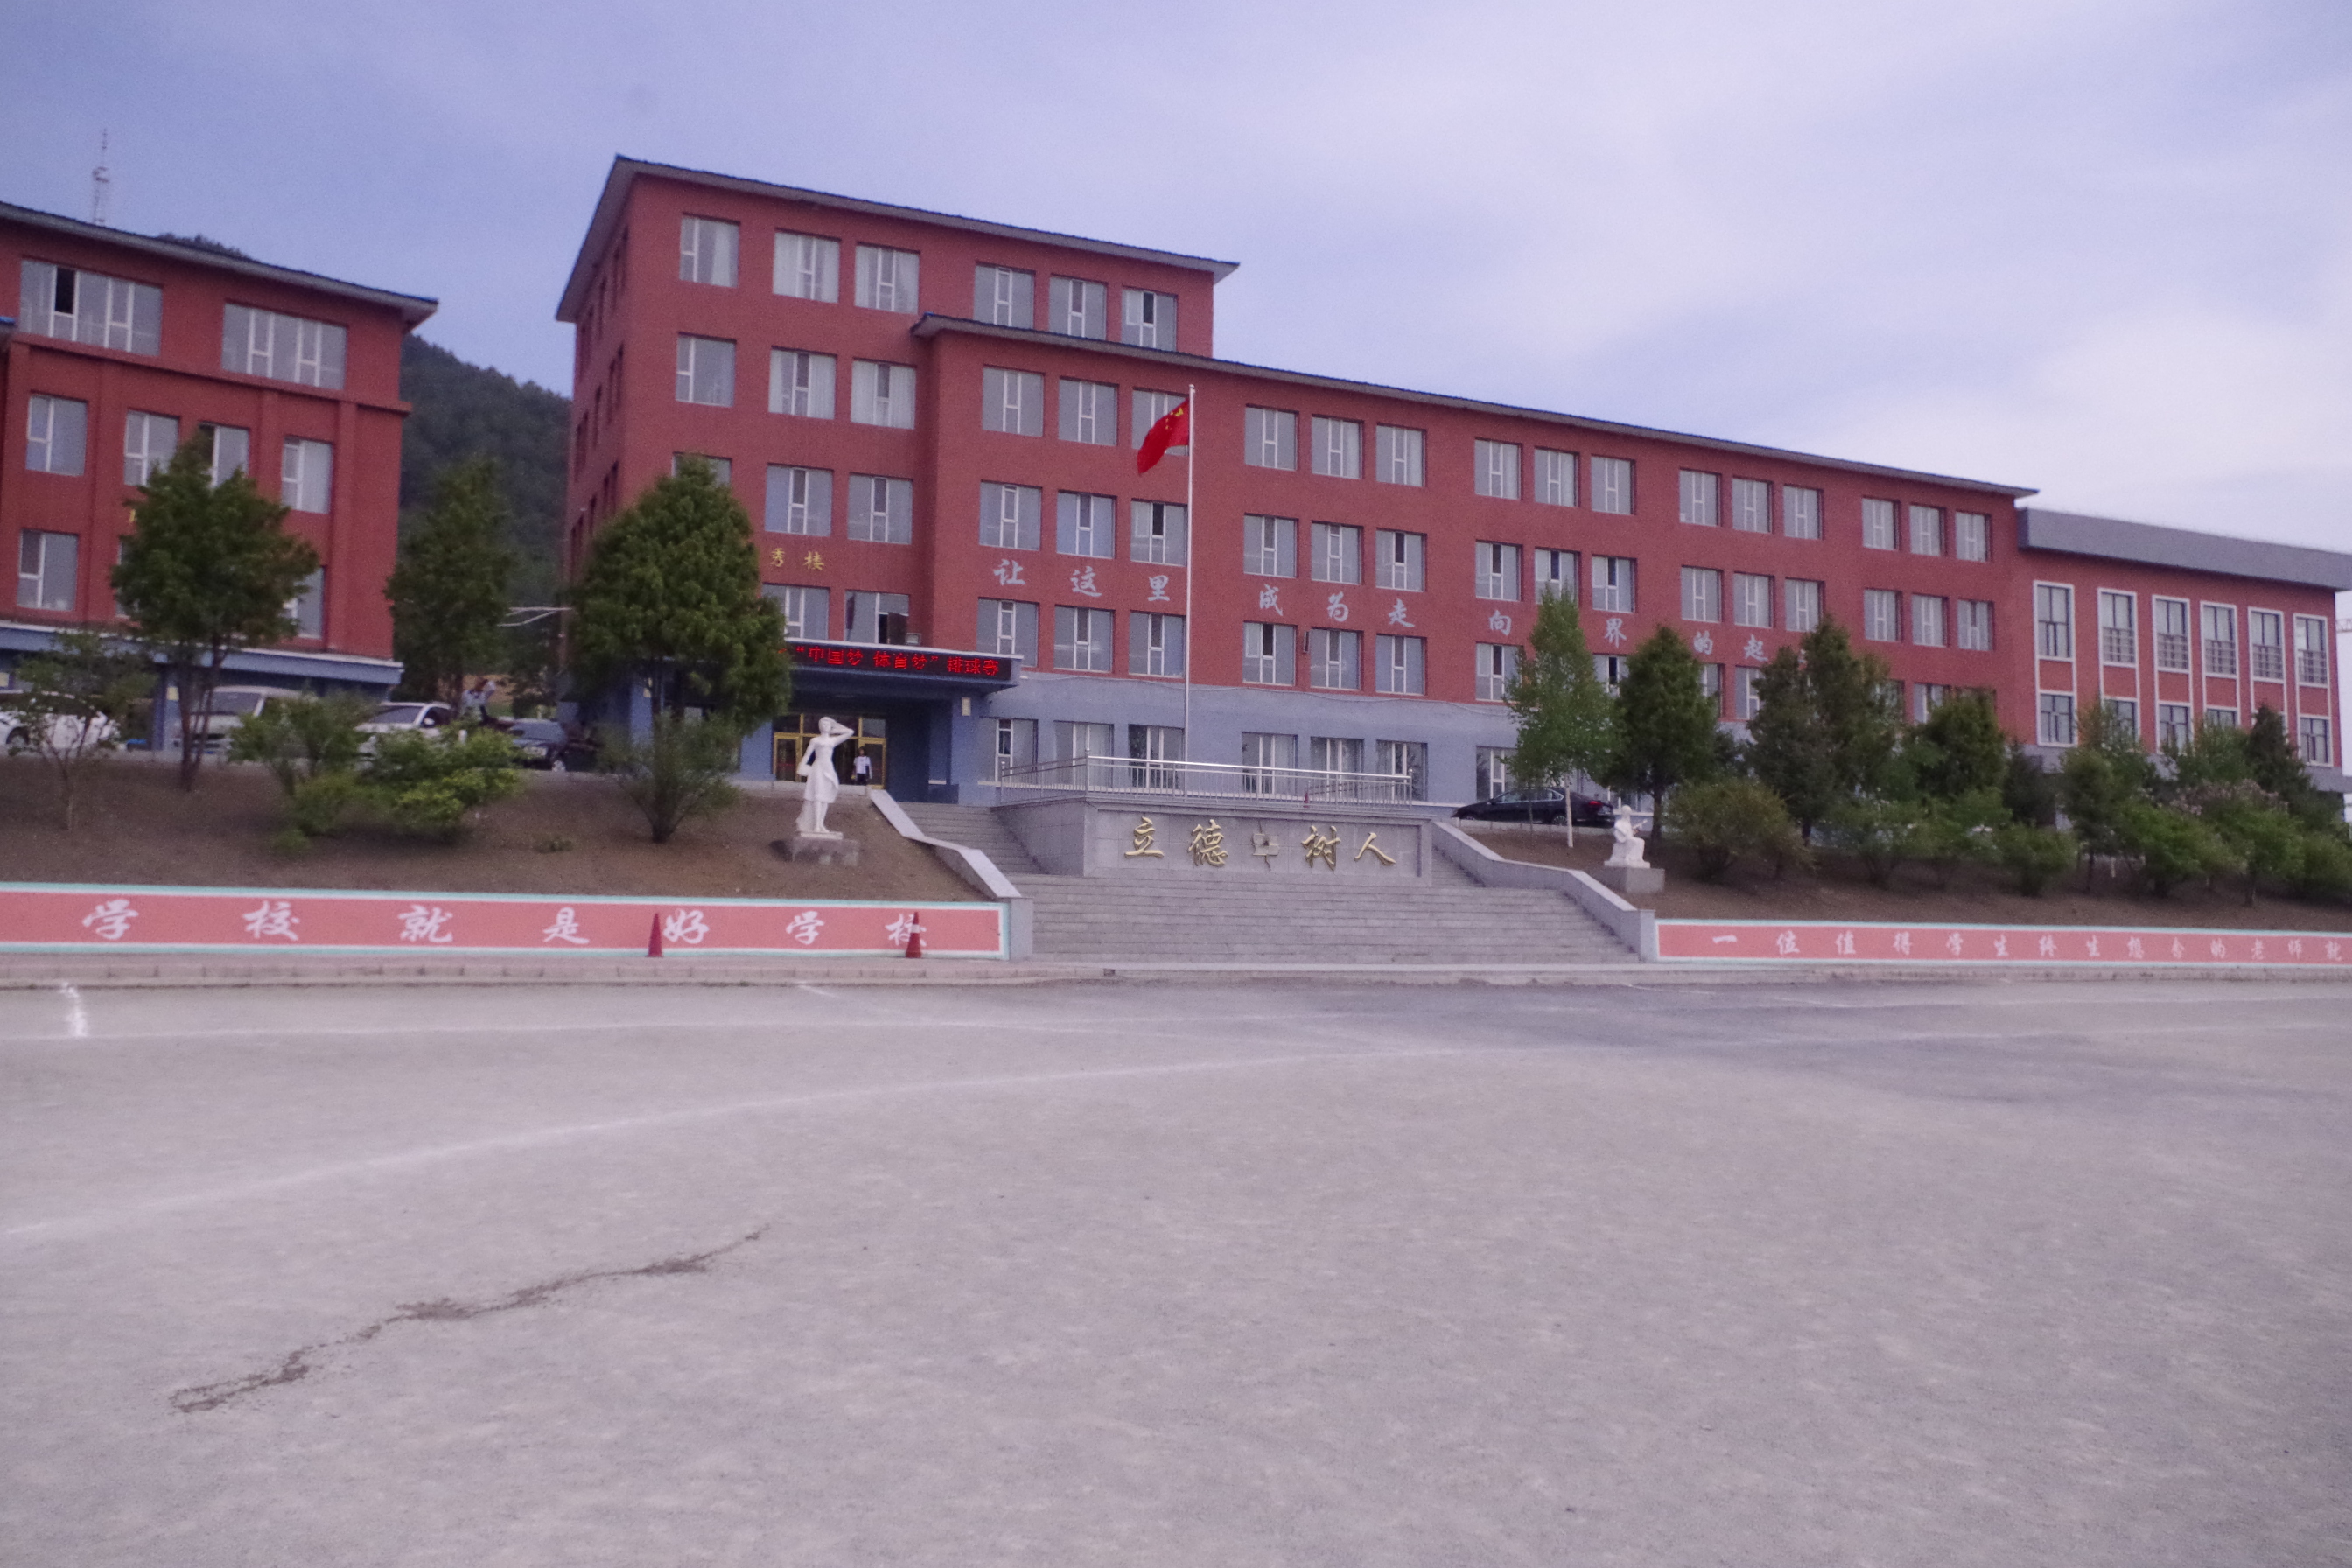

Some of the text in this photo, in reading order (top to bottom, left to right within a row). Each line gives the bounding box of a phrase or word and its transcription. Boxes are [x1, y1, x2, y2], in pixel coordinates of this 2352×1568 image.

[994, 559, 1808, 662] 让这里成为走向界的起
